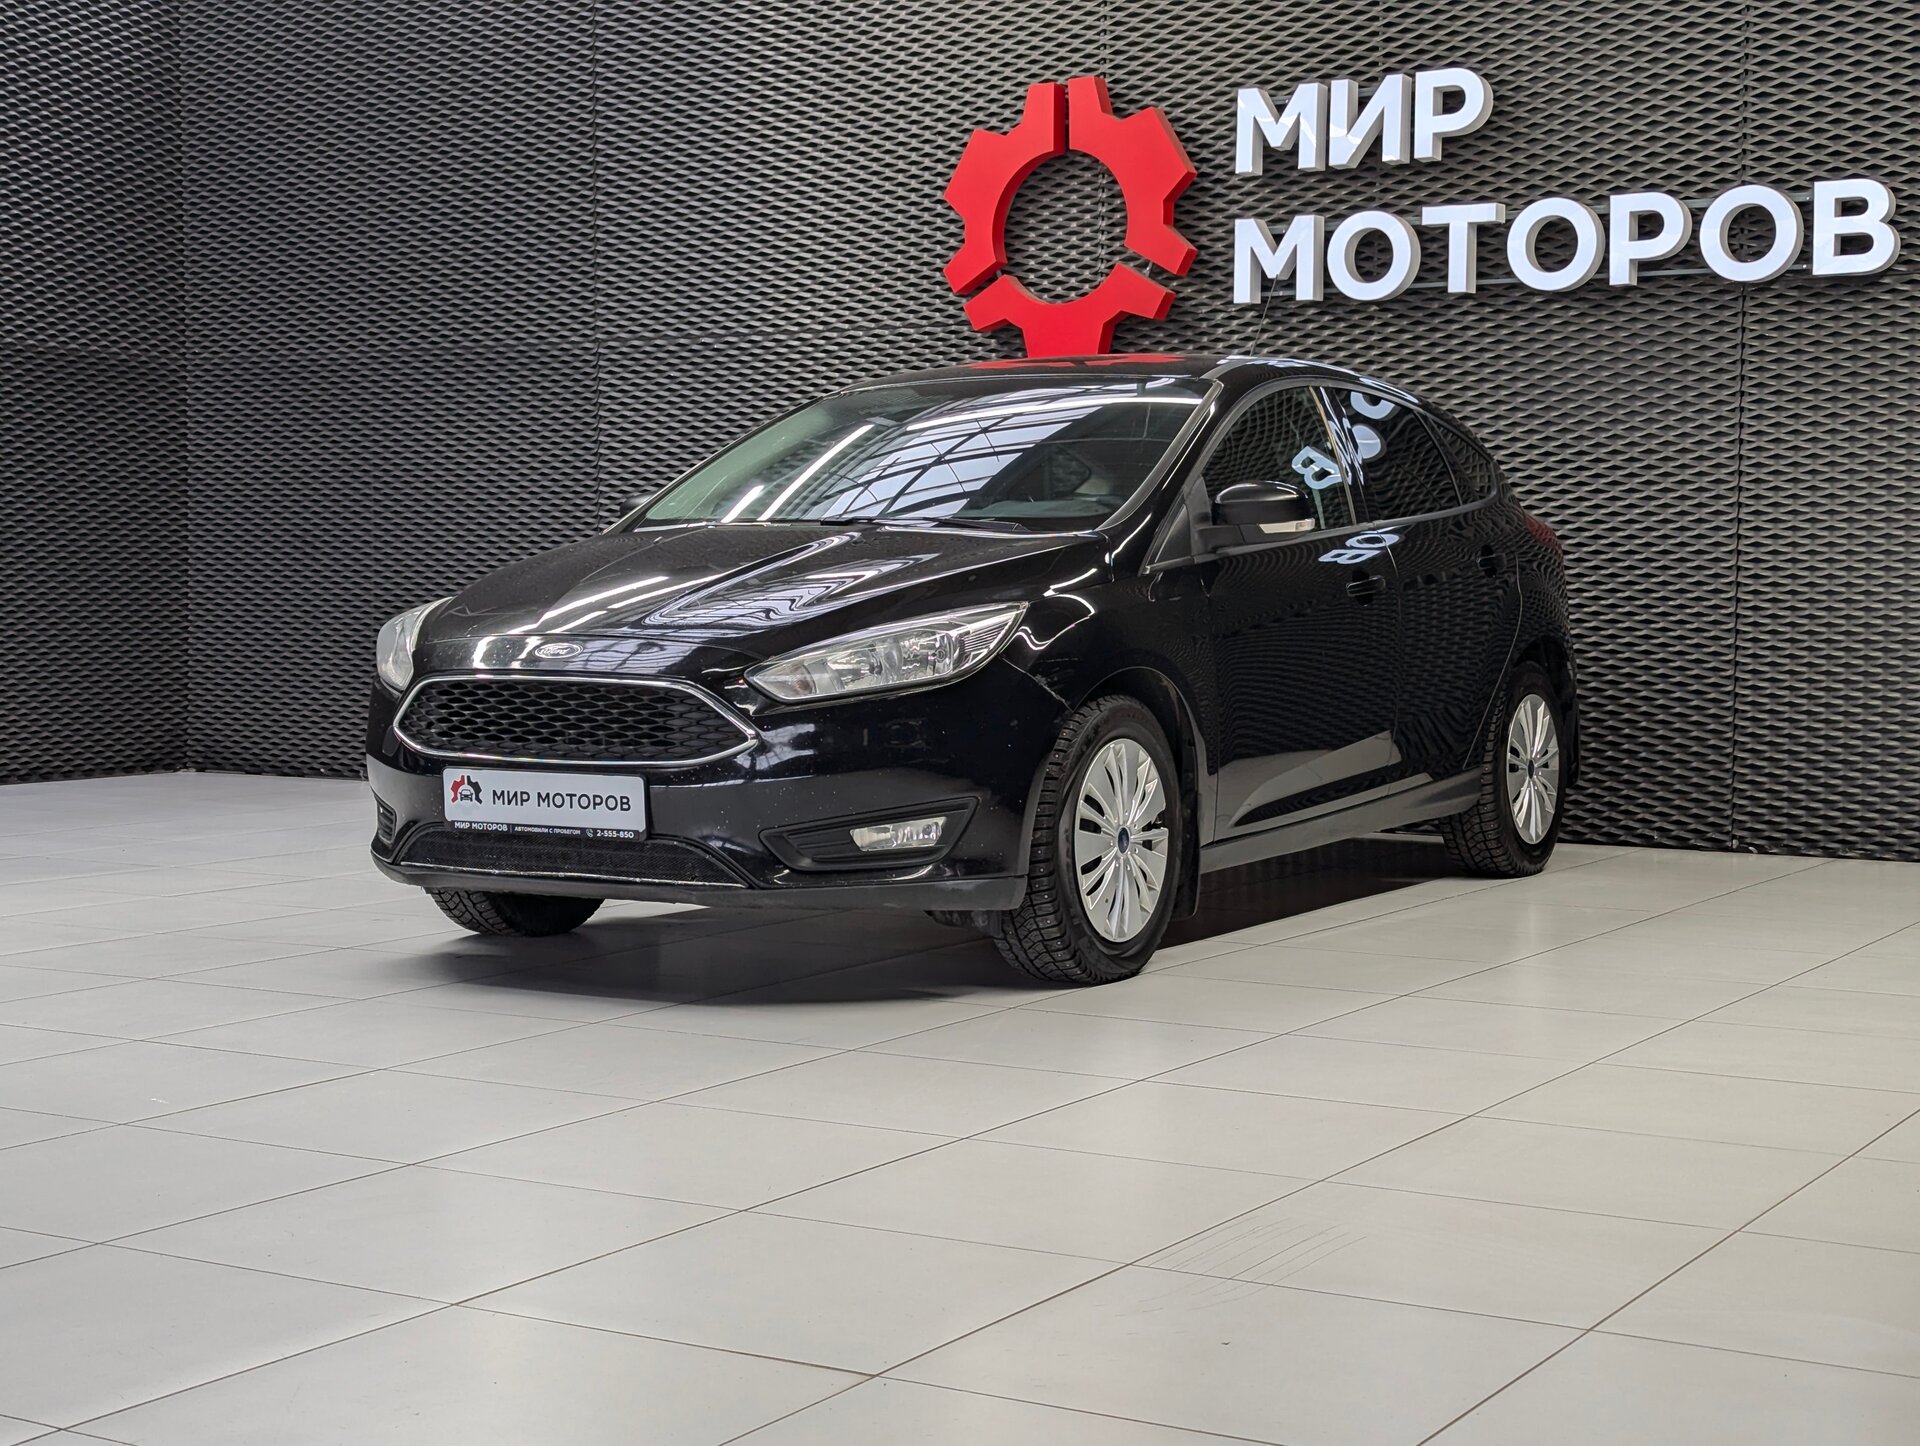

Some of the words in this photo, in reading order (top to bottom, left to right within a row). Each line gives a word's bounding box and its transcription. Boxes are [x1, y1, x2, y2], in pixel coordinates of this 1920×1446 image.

[1235, 67, 1494, 176] МИР
[1232, 178, 1900, 304] МОТОРОВ
[538, 647, 571, 656] Ford
[492, 789, 531, 807] МИР
[537, 791, 631, 812] МОТОРОВ
[454, 821, 470, 830] МИР
[471, 823, 508, 832] МОТОРОВ
[514, 826, 549, 834] АВТОМОБИЛИ
[596, 829, 634, 839] 2-555-850
